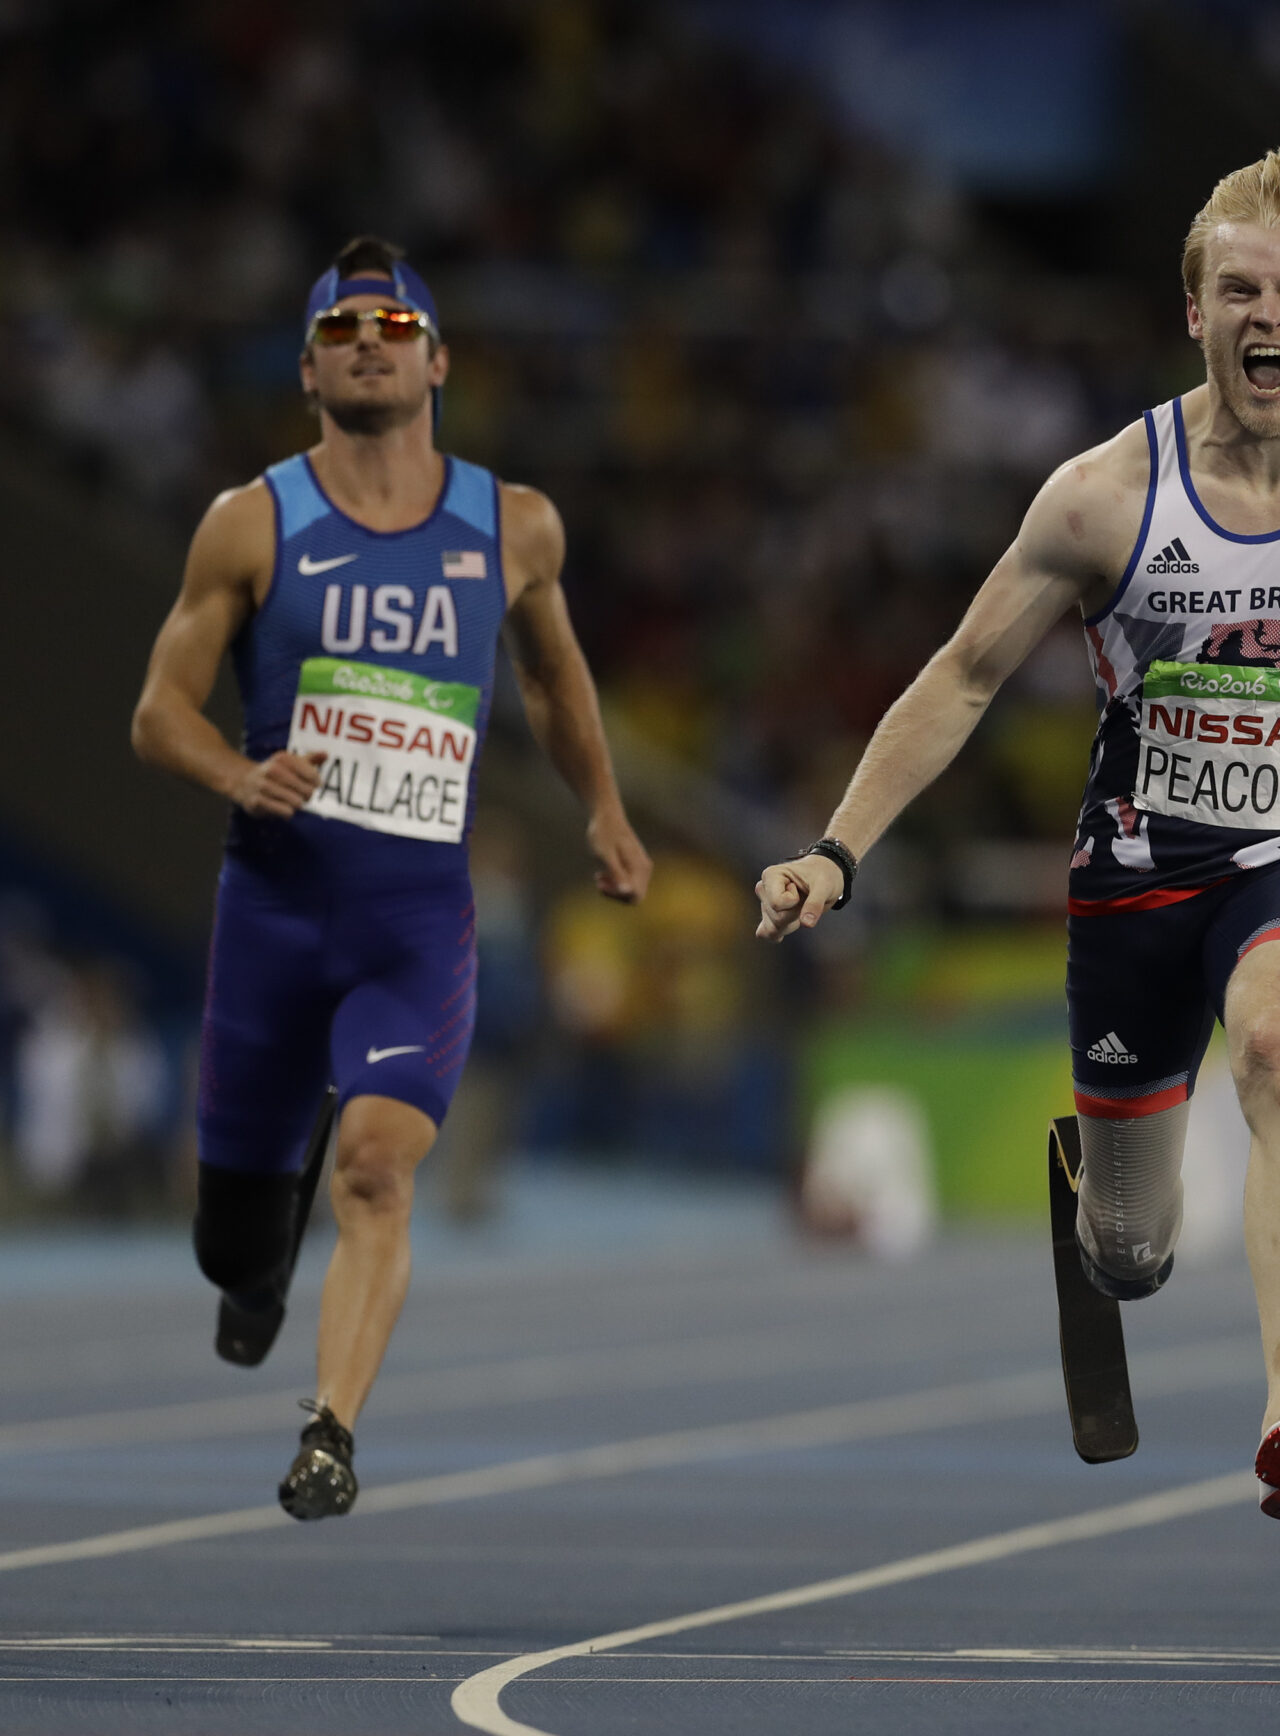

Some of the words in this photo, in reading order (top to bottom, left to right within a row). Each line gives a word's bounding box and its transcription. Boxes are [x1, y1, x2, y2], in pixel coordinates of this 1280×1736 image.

[1147, 561, 1200, 574] adidas
[1148, 590, 1242, 614] GREAT
[321, 585, 458, 657] USA
[1180, 670, 1267, 696] Rio2016
[300, 703, 471, 762] NISSAN
[292, 748, 460, 826] ALLACE
[1087, 1049, 1139, 1064] adidas
